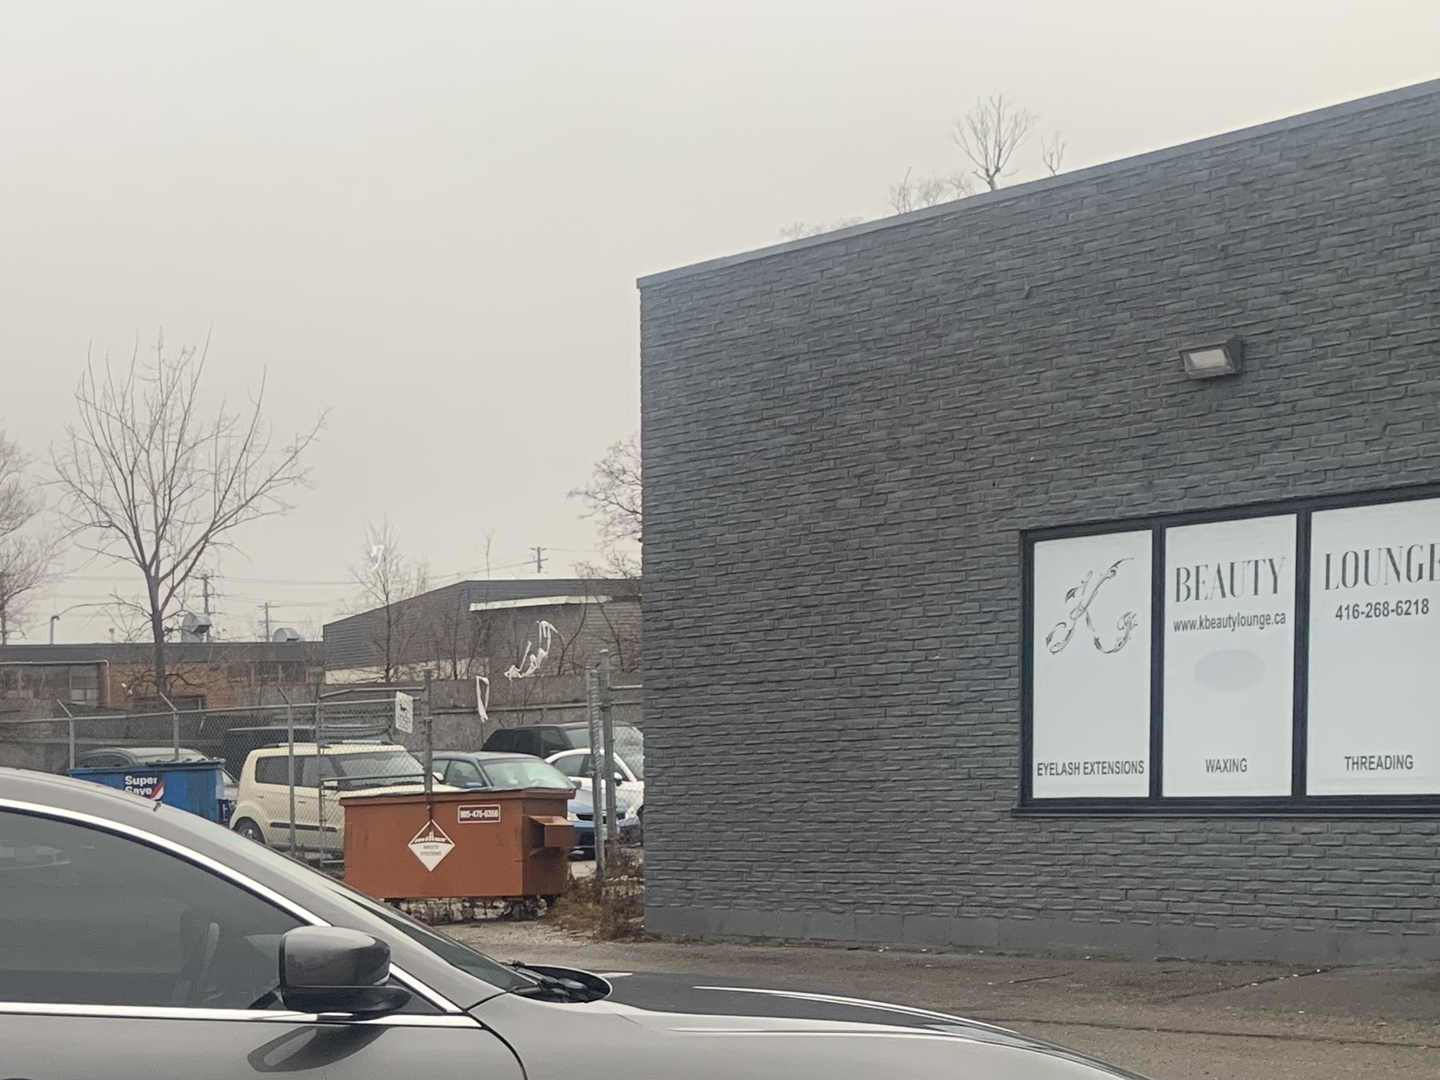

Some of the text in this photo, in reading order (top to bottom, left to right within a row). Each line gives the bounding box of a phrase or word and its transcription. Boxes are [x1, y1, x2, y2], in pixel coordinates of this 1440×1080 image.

[1174, 543, 1440, 603] BEAUTY LOUNGE
[1334, 597, 1431, 621] 416-268-6218
[1172, 611, 1287, 633] www.kbeautylounge.ca
[1036, 759, 1145, 777] EYELASH EXTENSIONS
[1205, 757, 1248, 773] WAXING
[1344, 754, 1415, 771] THREADING
[124, 775, 158, 787] Super
